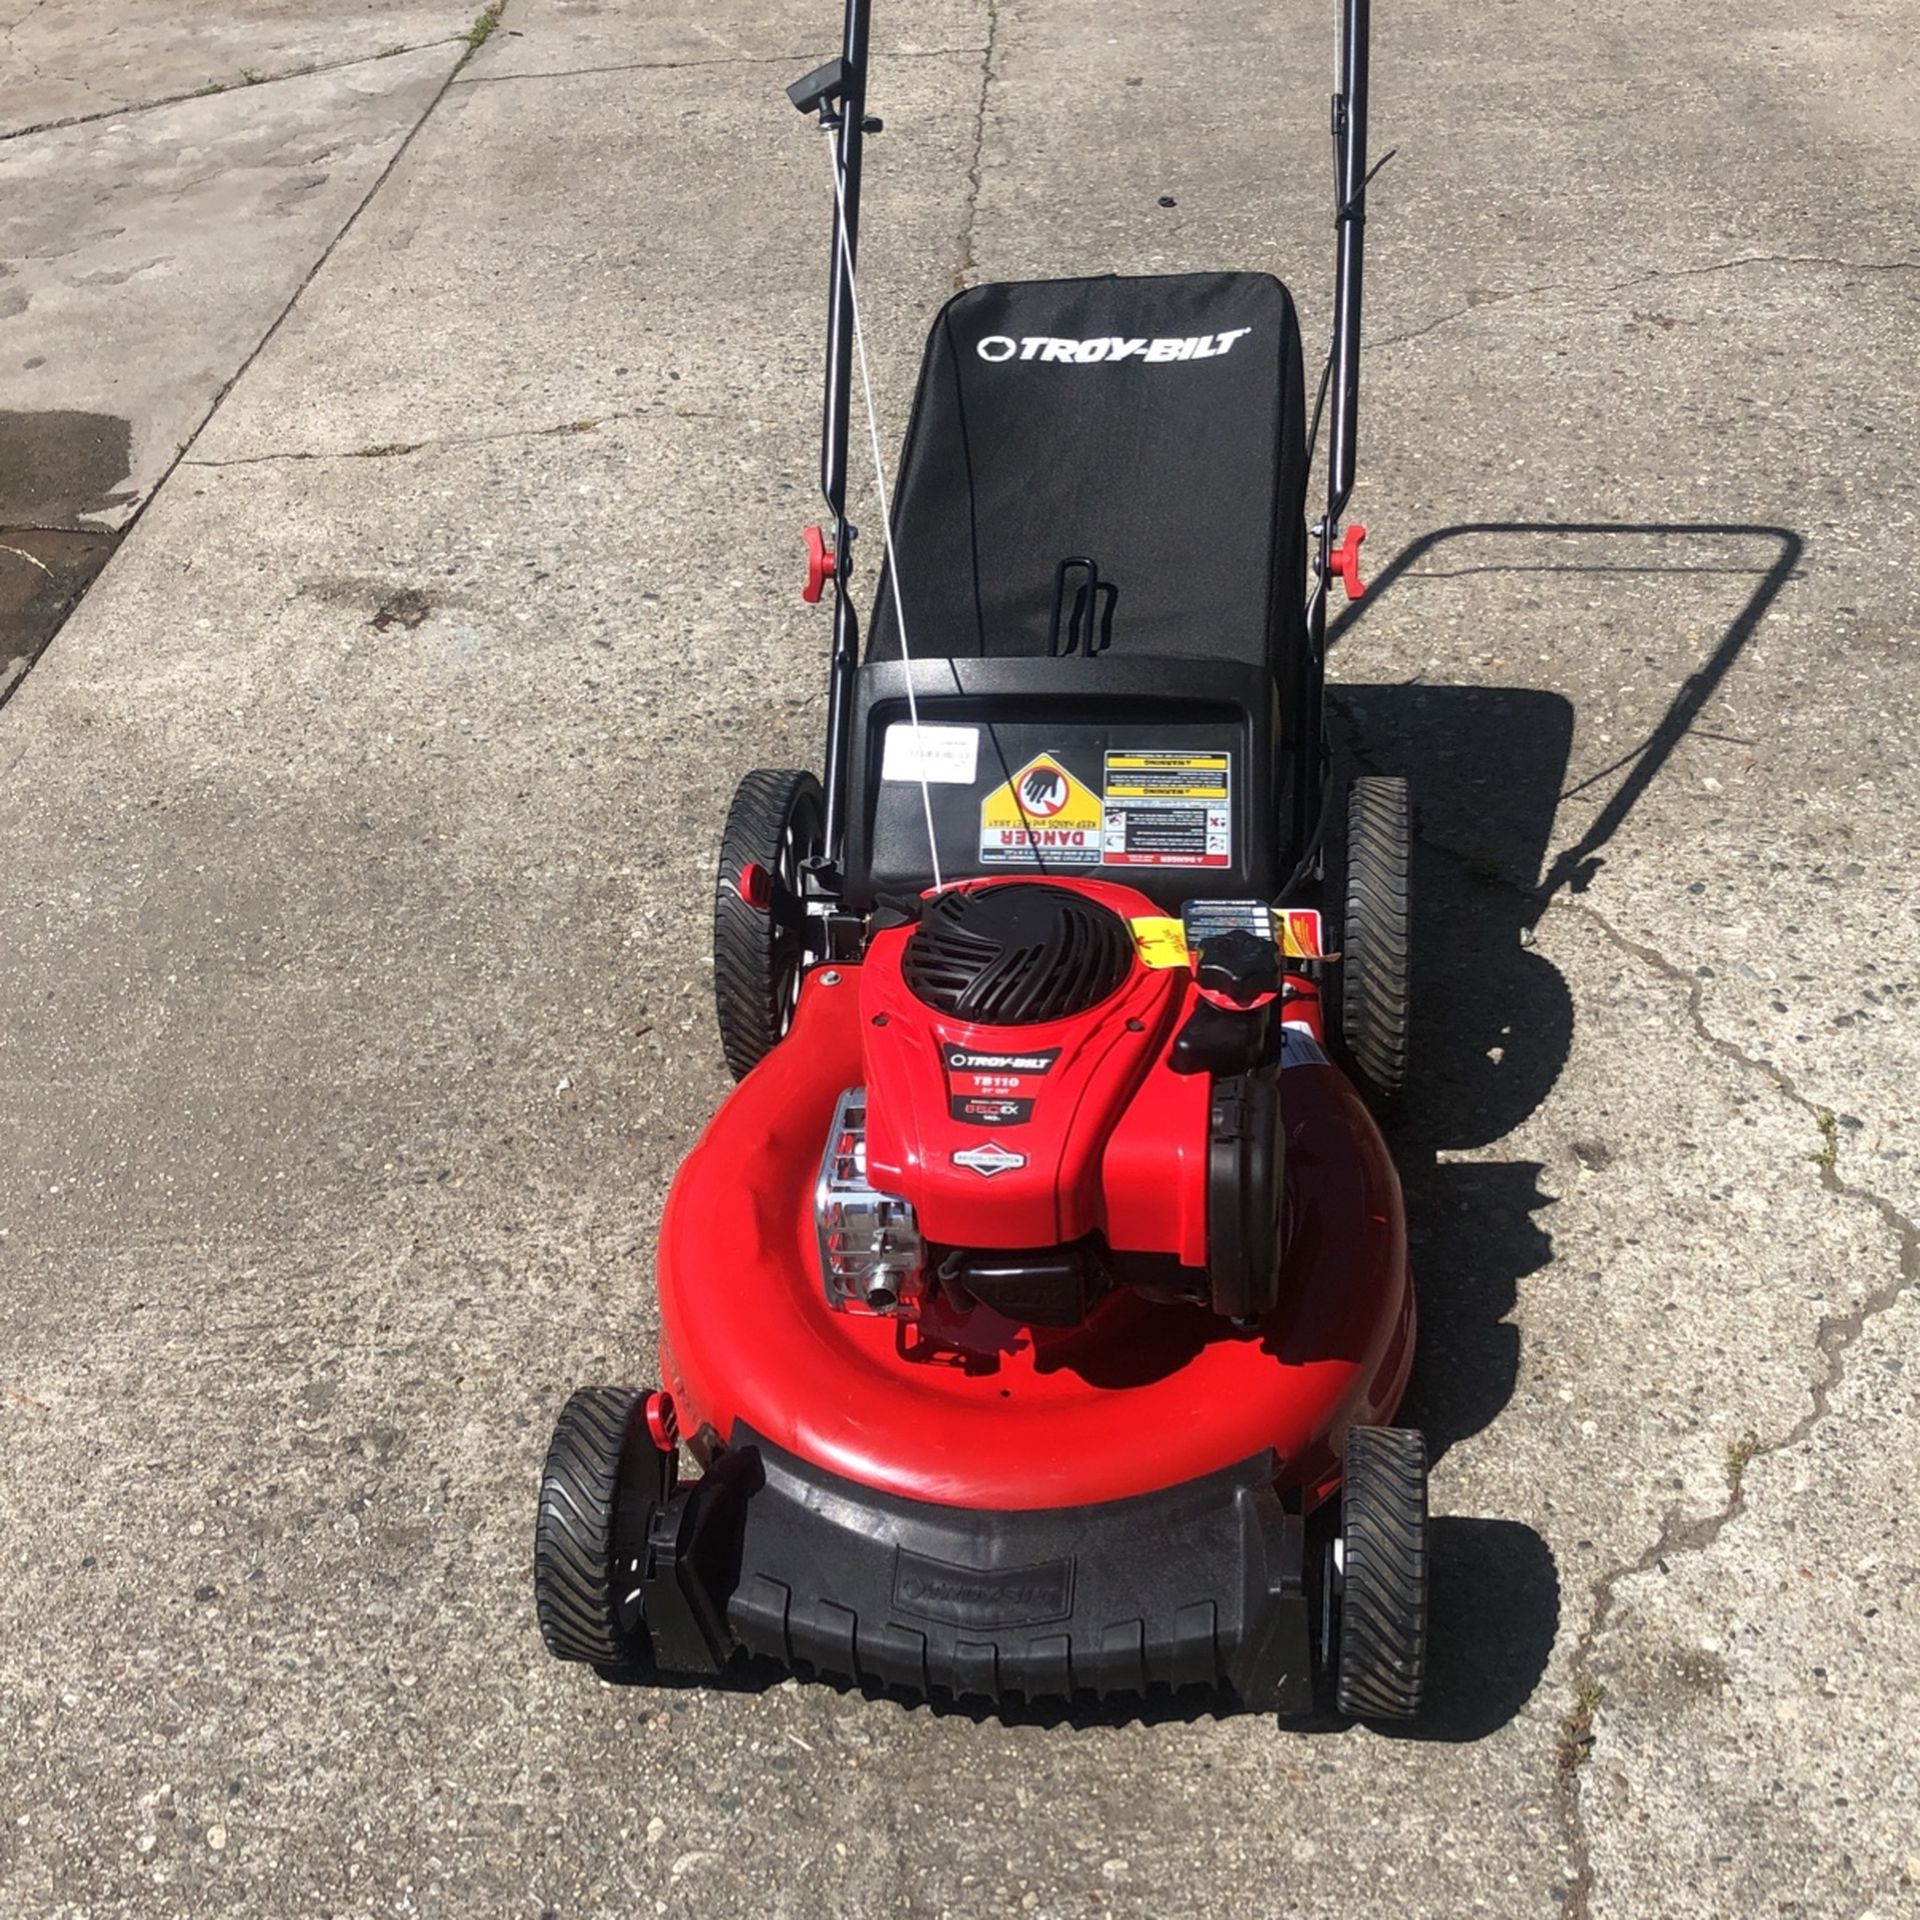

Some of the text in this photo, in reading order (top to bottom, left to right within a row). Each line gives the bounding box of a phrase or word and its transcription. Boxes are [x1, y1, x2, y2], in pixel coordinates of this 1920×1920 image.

[1019, 328, 1248, 363] TROY-BILT
[988, 819, 1011, 828] AWAY
[1048, 819, 1074, 829] HANDS
[1076, 819, 1097, 829] KEEP
[1001, 830, 1085, 846] DANGER
[967, 1056, 1050, 1069] TROY-BILT
[973, 1076, 1019, 1087] TB110
